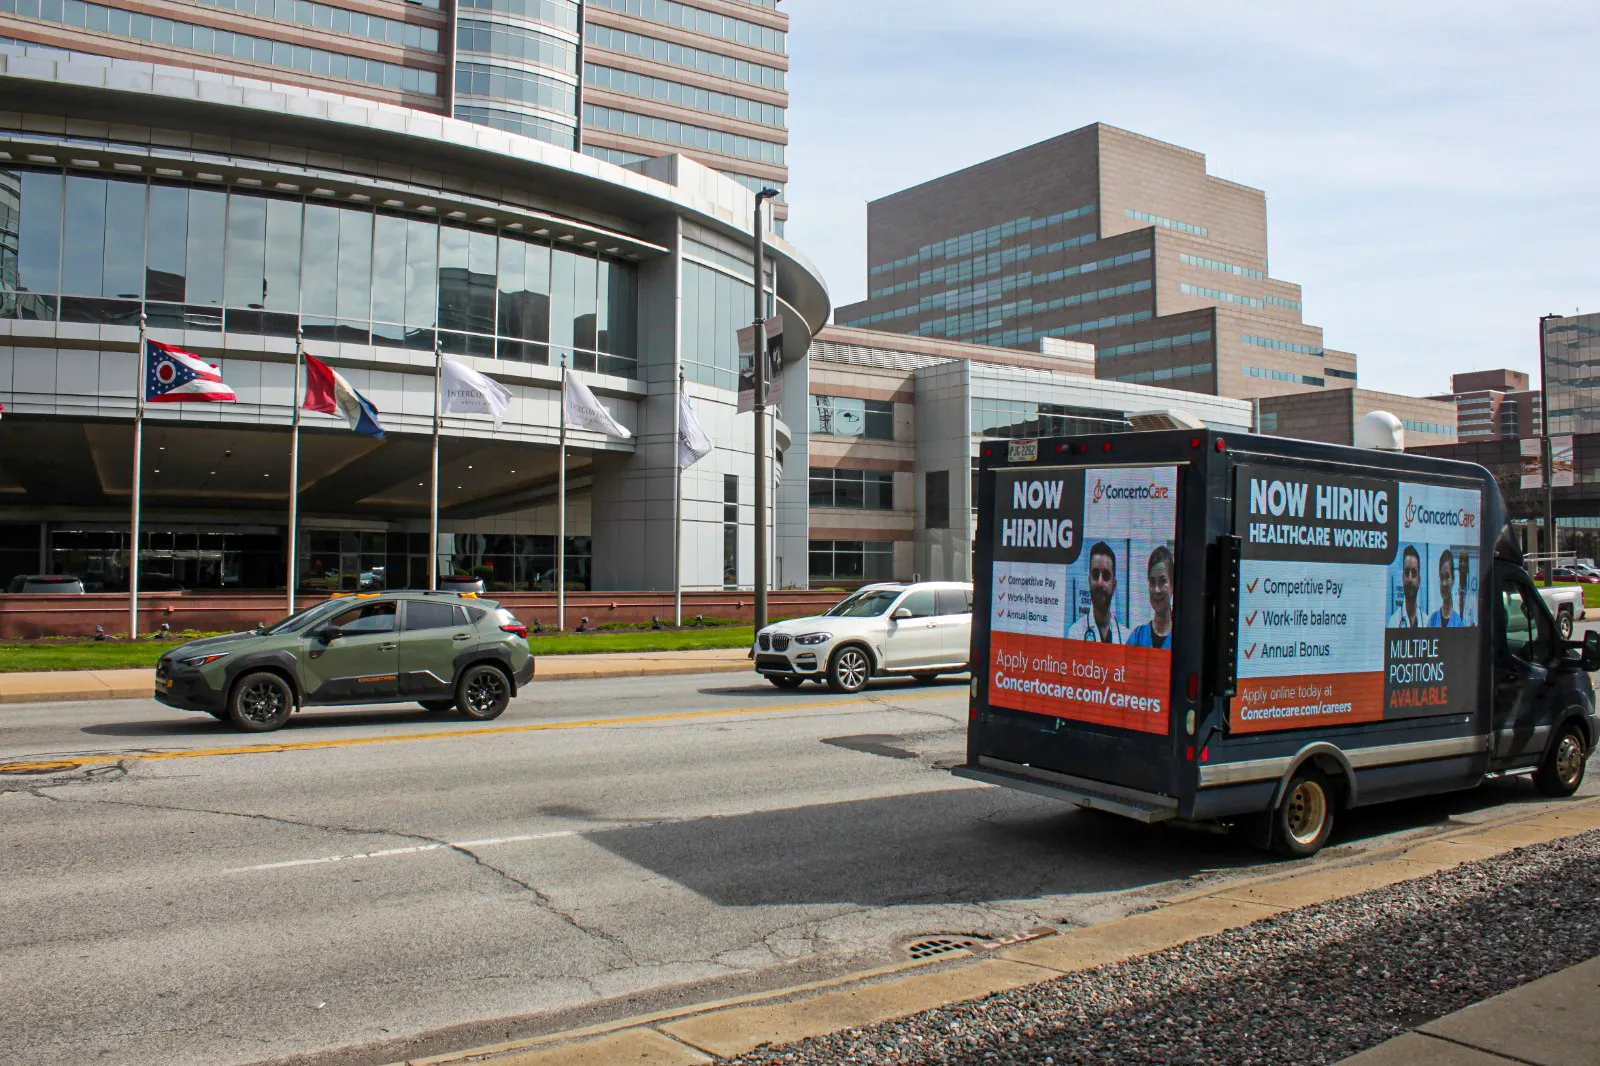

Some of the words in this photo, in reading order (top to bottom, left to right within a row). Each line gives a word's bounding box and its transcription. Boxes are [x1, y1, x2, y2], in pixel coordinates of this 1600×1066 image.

[1013, 480, 1064, 510] NOW
[1105, 483, 1169, 500] ConcertoCare
[1250, 478, 1308, 518] NOW
[1315, 484, 1388, 525] HIRING
[1417, 504, 1475, 528] ConcertoCare
[1002, 518, 1073, 549] HIRING
[1249, 522, 1331, 546] HEALTHCARE
[1333, 527, 1388, 550] WORKERS
[1007, 575, 1044, 588] Competitive
[1044, 577, 1056, 589] Pay
[1263, 577, 1324, 598] Competitive
[1325, 579, 1343, 599] Pay
[1007, 593, 1034, 604] Work-life
[1034, 594, 1059, 605] balance
[1006, 610, 1028, 620] Annual
[1028, 611, 1048, 622] Bonus
[1262, 609, 1308, 626] Work-life
[1310, 609, 1347, 626] balance
[1260, 640, 1297, 659] Annual
[1299, 641, 1330, 657] Bonus
[1390, 638, 1440, 659] MULTIPLE
[996, 648, 1029, 673] Apply
[1032, 654, 1068, 676] online
[1072, 658, 1108, 685] today
[1113, 665, 1126, 683] at
[1389, 661, 1445, 684] POSITIONS
[995, 671, 1161, 713] Concertocare.com/careers
[1241, 684, 1268, 705] Apply
[1270, 685, 1296, 700] online
[1298, 683, 1322, 700] today
[1324, 683, 1333, 697] at
[1389, 686, 1449, 708] AVAILABLE
[1240, 701, 1352, 721] Concertocare.com/careers
